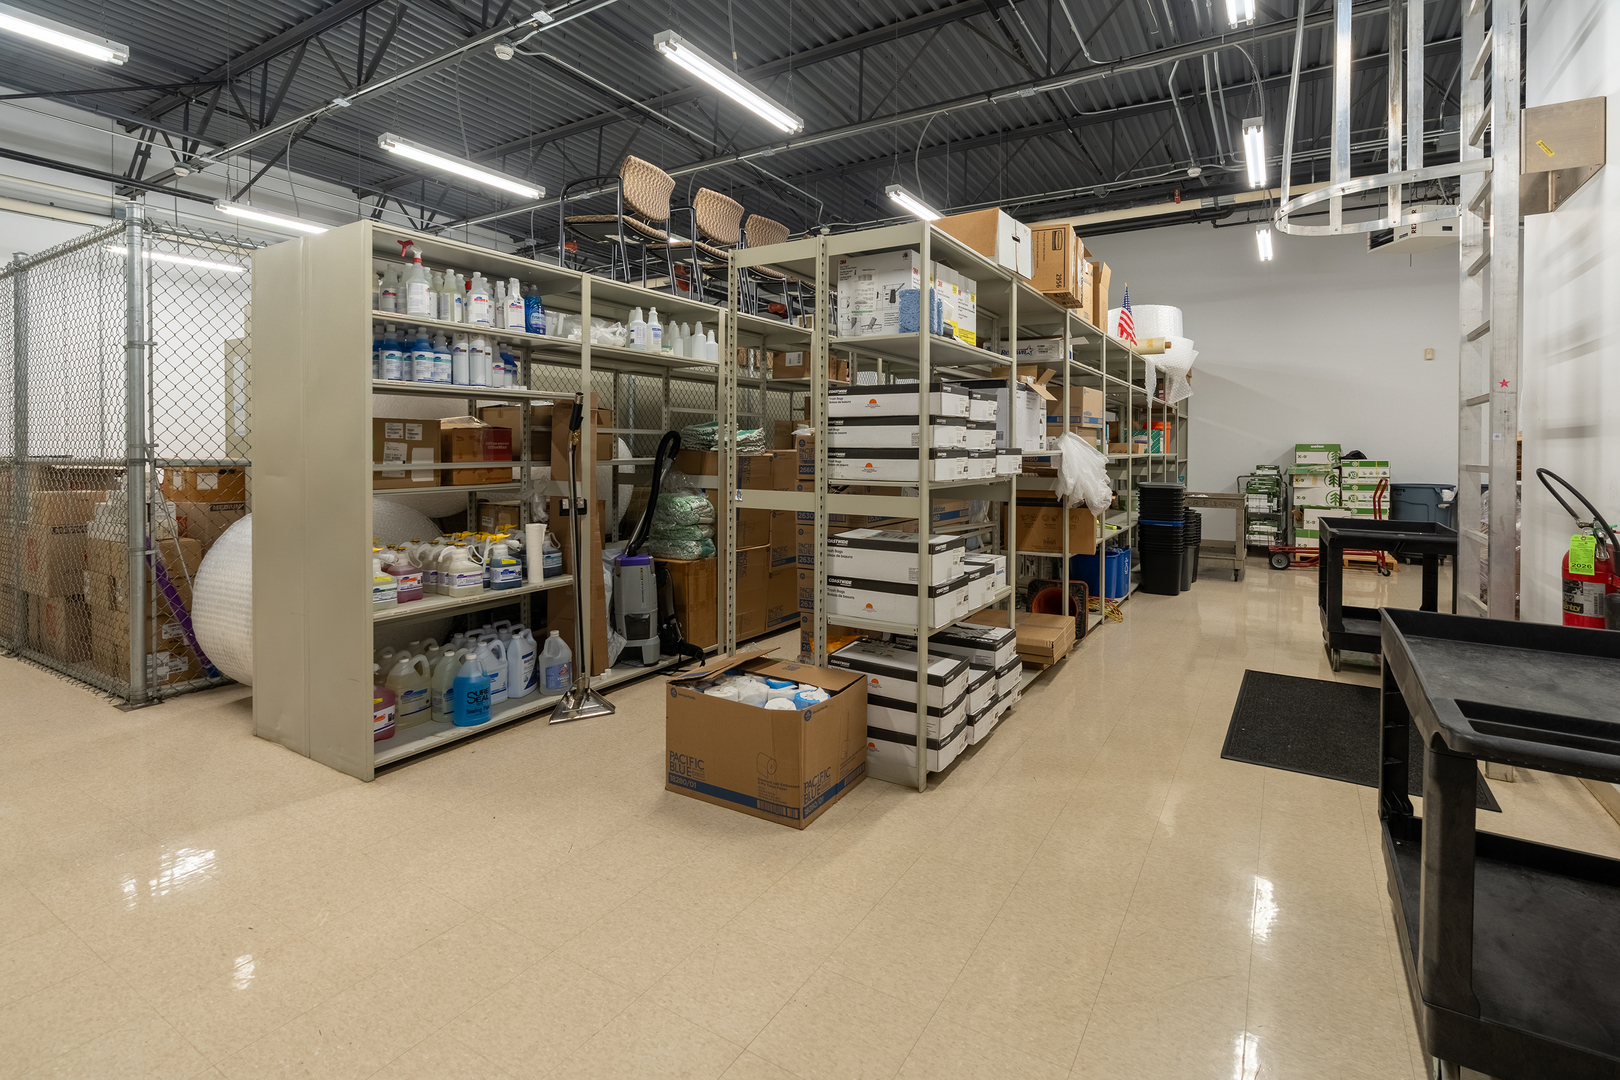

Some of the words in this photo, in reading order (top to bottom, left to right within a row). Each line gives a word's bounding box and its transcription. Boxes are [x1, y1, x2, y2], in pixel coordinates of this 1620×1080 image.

[670, 750, 704, 770] PACIFIC
[670, 762, 692, 777] BLUE
[670, 775, 697, 788] 18280/01
[804, 767, 831, 793] PACIFIC
[804, 784, 821, 805] BLUE
